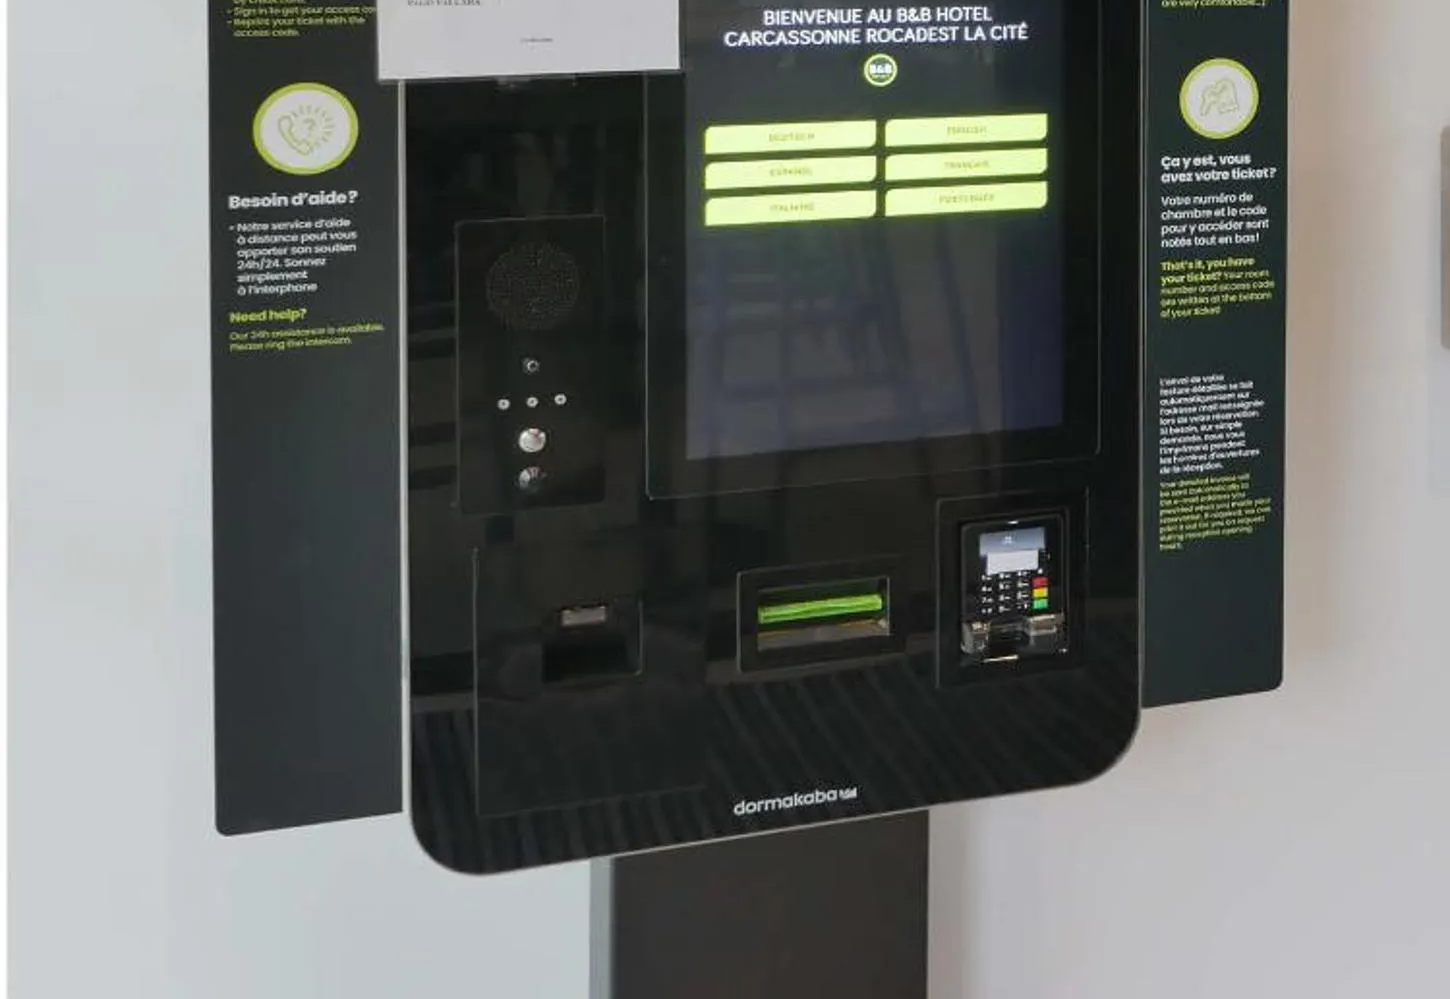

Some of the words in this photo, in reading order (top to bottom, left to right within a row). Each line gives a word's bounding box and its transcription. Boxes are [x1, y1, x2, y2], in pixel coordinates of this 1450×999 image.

[764, 10, 863, 26] BIENVENUE
[868, 8, 892, 23] AU
[897, 8, 931, 23] B&B
[936, 6, 992, 22] HOTEL
[724, 30, 861, 47] CARCASSONNE
[865, 28, 959, 44] ROCADEST
[963, 27, 985, 41] LA
[991, 22, 1028, 40] CITÉ
[1161, 156, 1180, 170] Ça
[1183, 157, 1191, 169] y
[1220, 155, 1251, 165] vous
[1161, 171, 1193, 183] avez
[1195, 169, 1229, 181] votre
[228, 193, 288, 210] Besoin
[230, 311, 267, 323] Need
[269, 308, 307, 321] help?
[733, 789, 838, 816] dormakaba
